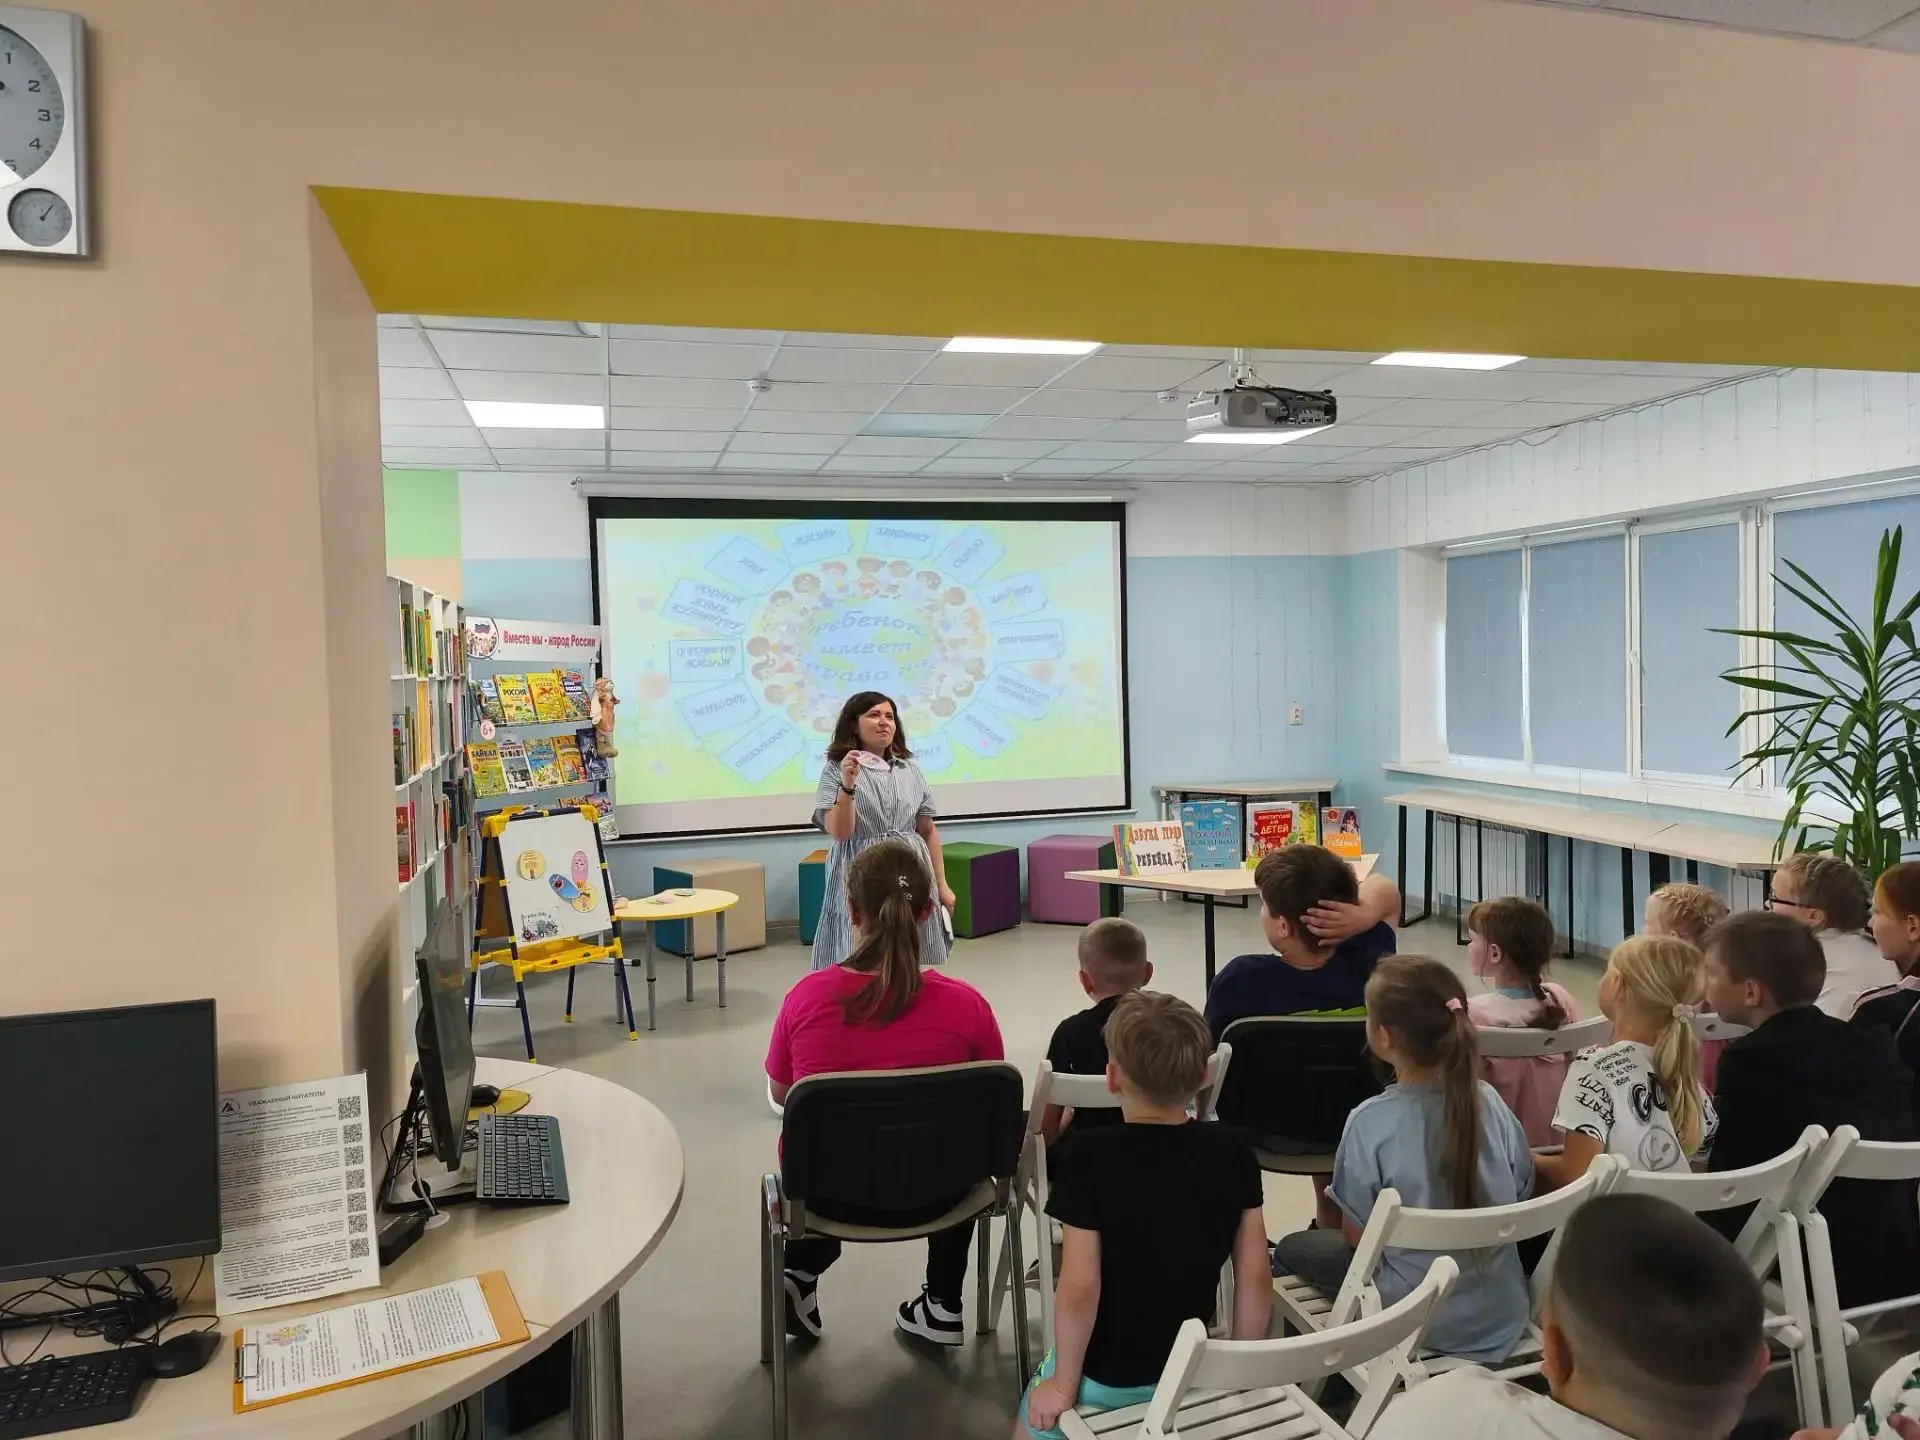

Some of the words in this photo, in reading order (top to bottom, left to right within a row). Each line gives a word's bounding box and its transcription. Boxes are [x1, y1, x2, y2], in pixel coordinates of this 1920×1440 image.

[5, 52, 12, 65] 1
[28, 79, 41, 93] 2
[37, 108, 51, 122] 3
[28, 137, 42, 151] 4
[503, 630, 530, 645] Вместе
[531, 635, 543, 646] мы
[548, 636, 570, 648] народ
[570, 634, 596, 648] России
[482, 723, 493, 736] 6+
[1128, 826, 1160, 845] АЗБУКА
[1260, 824, 1290, 835] ДЕТЕЙ
